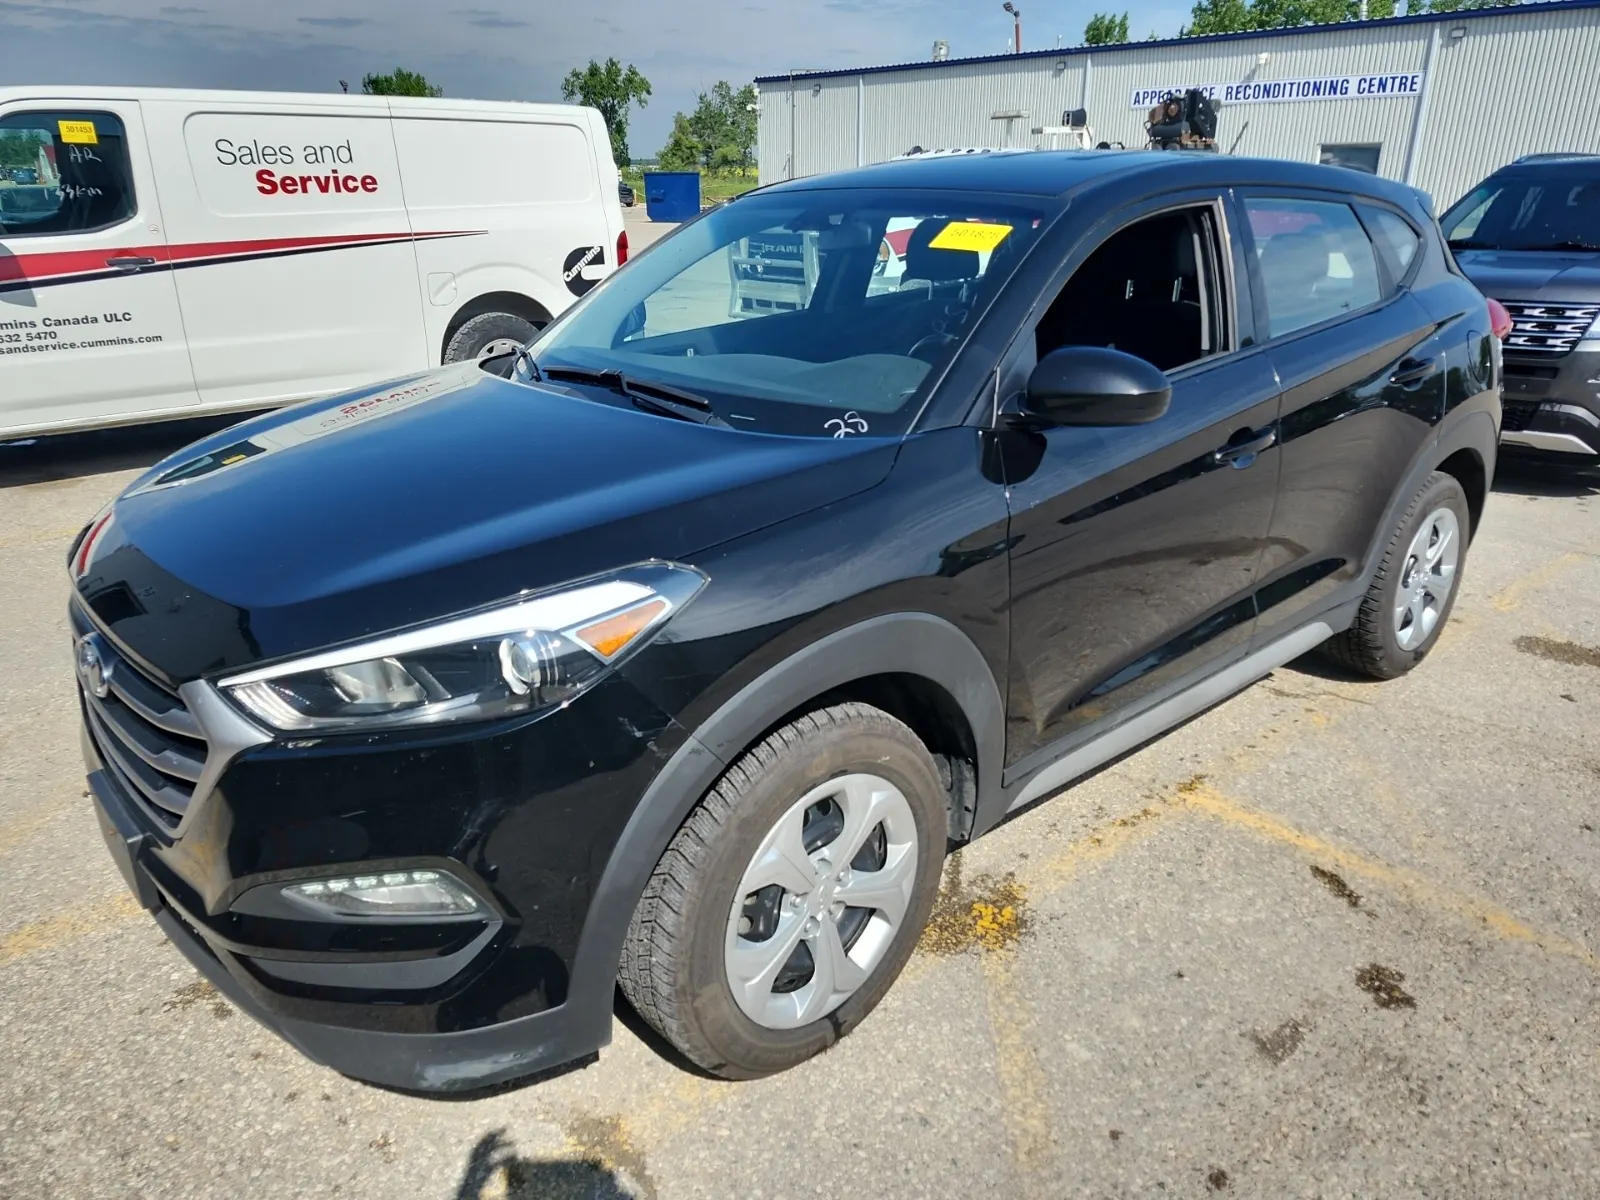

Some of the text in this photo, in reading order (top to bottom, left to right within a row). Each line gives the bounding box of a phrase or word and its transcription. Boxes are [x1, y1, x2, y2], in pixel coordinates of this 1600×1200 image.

[1225, 79, 1350, 101] RECONDITIONING
[1357, 75, 1420, 95] CENTRE
[215, 138, 354, 166] Sales and
[255, 169, 378, 195] Service
[764, 244, 798, 254] RAM
[563, 245, 601, 282] Cummins
[42, 315, 98, 327] Canada
[103, 312, 132, 323] ULC
[0, 334, 163, 356] sandservice.cummins.com
[25, 330, 57, 342] 5470
